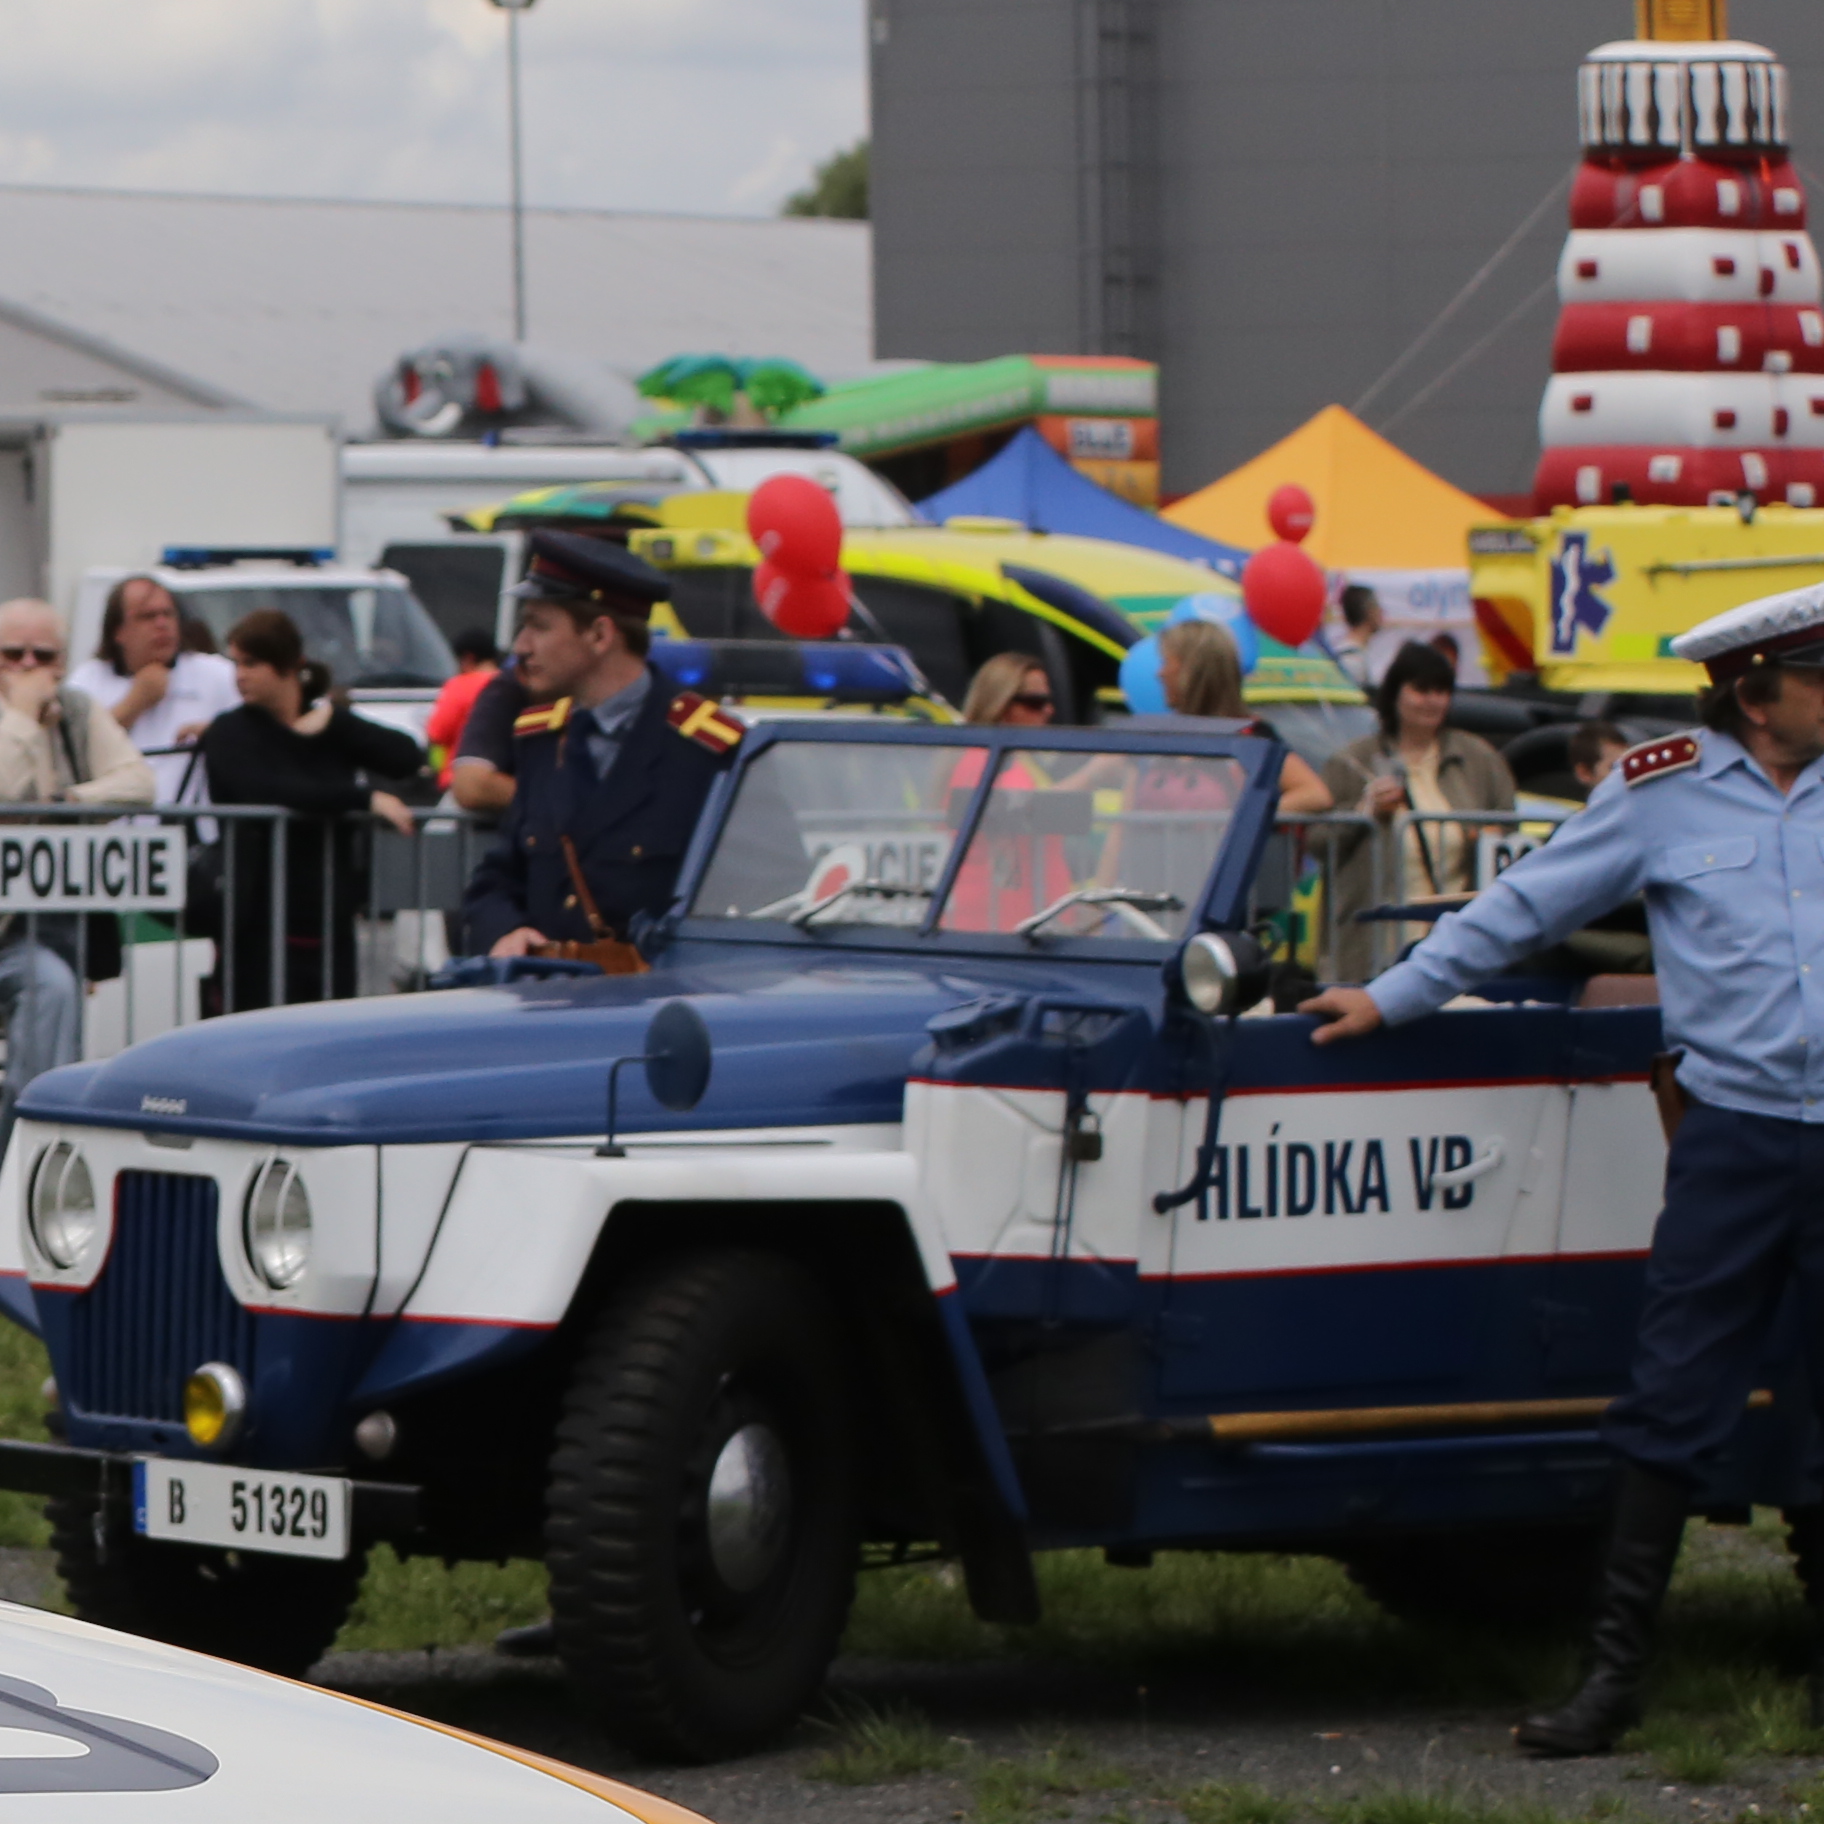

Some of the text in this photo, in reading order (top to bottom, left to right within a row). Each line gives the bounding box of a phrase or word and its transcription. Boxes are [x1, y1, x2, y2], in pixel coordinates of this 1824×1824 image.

[0, 838, 168, 898] POLICIE
[1196, 1121, 1475, 1221] HLÍDKA VB
[168, 1478, 328, 1538] B 51329
